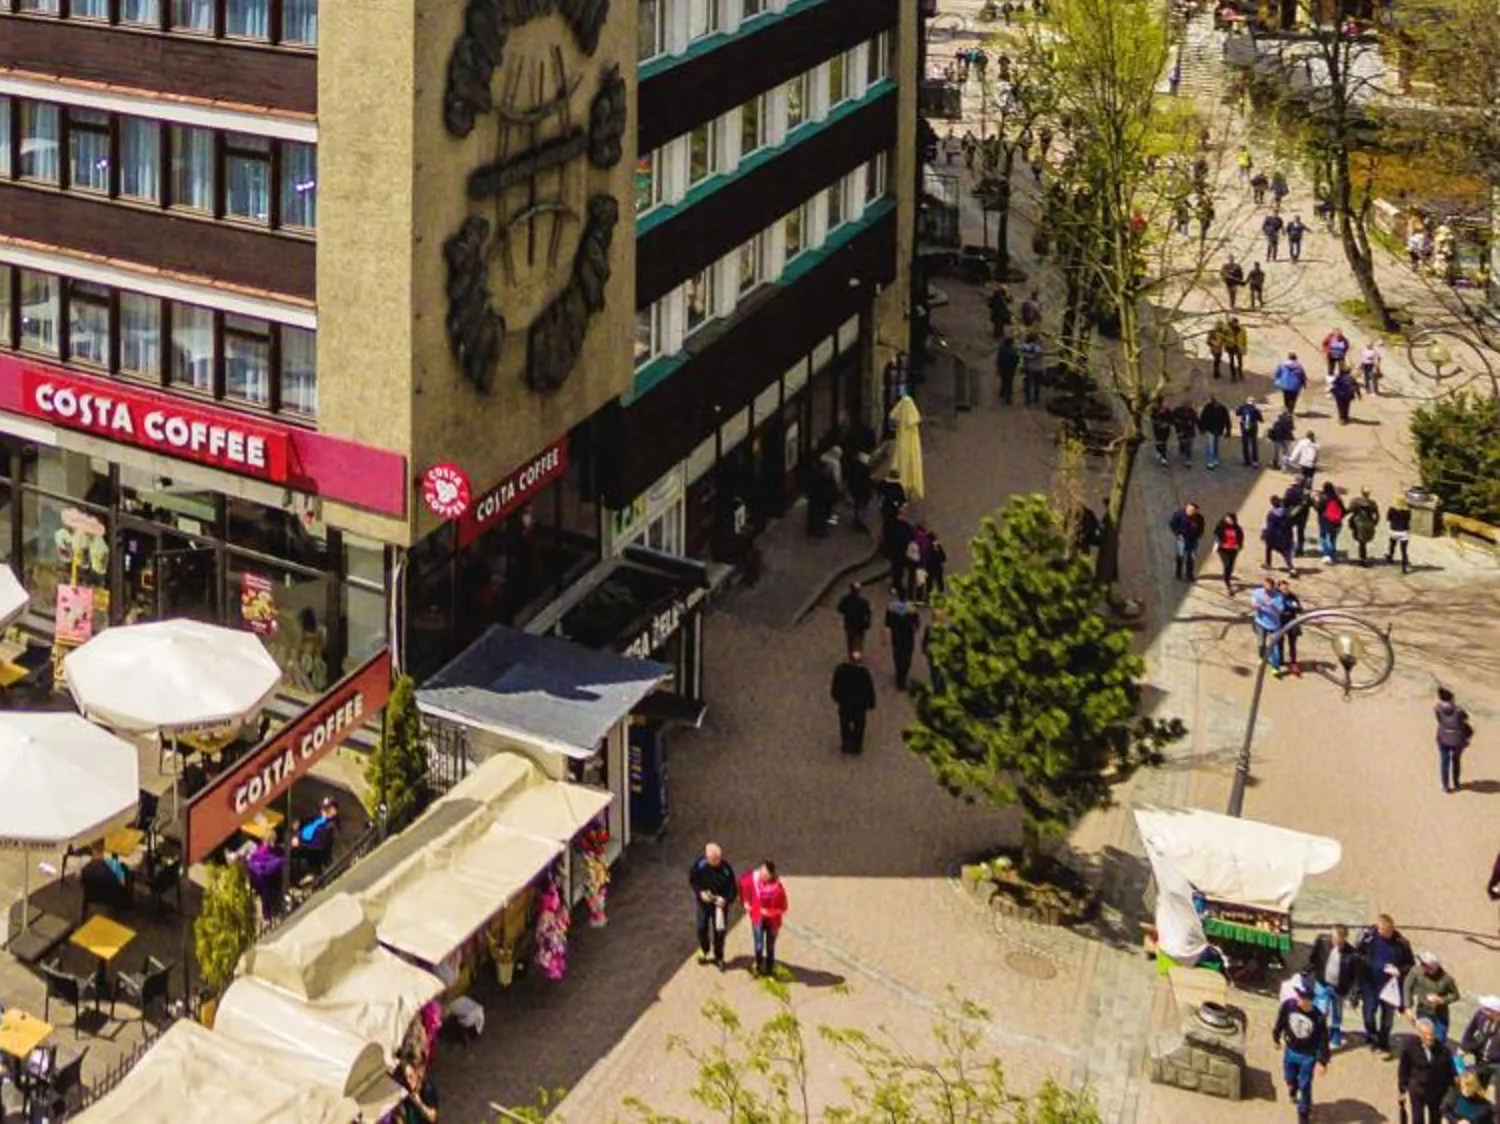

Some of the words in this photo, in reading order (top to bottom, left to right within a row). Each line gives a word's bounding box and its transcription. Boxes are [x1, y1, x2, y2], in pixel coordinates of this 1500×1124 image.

[35, 383, 134, 433] COSTA
[143, 411, 266, 468] COFFEE
[425, 492, 467, 516] COFFEE
[428, 467, 463, 486] COSTA
[477, 481, 515, 521] COSTA
[519, 447, 559, 490] COFFEE
[234, 749, 296, 814] COSTA
[301, 692, 365, 760] COFFEE
